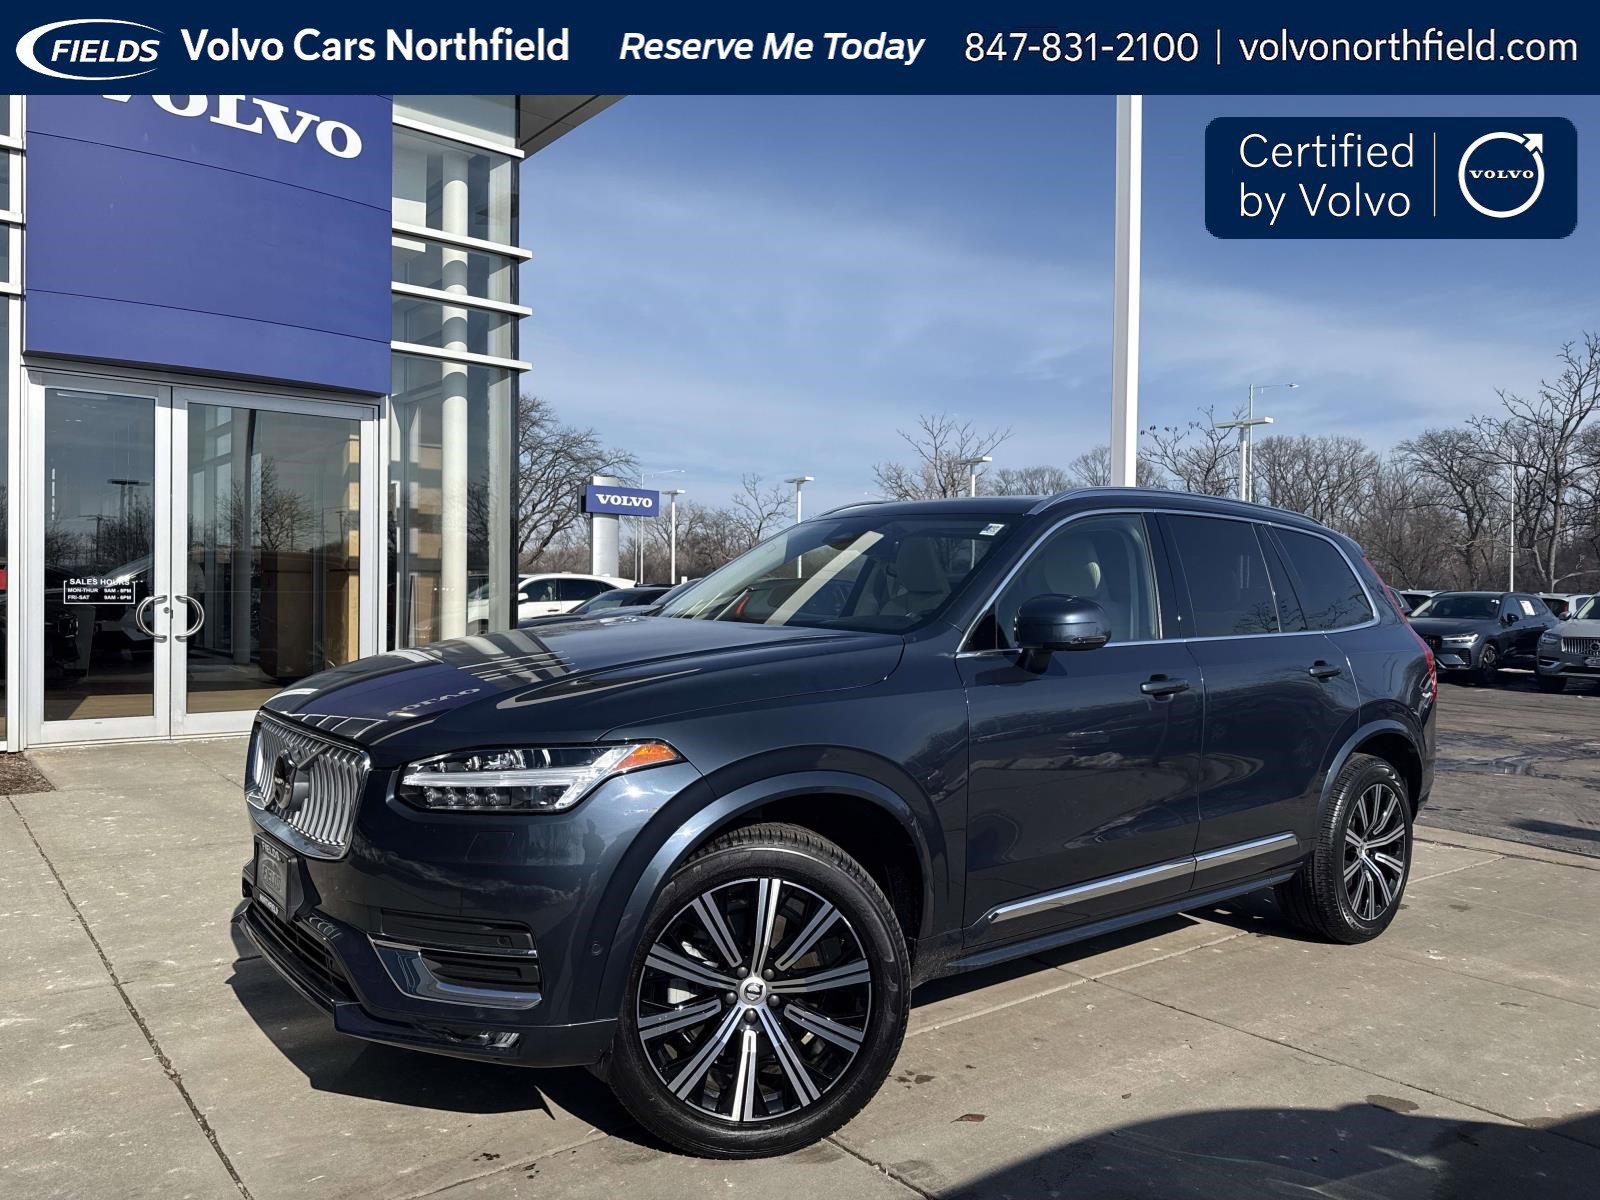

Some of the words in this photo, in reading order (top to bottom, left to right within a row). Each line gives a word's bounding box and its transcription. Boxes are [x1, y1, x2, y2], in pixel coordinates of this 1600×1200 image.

[102, 95, 362, 159] OLVO
[595, 493, 653, 508] VOLVO
[100, 578, 130, 586] HOURS
